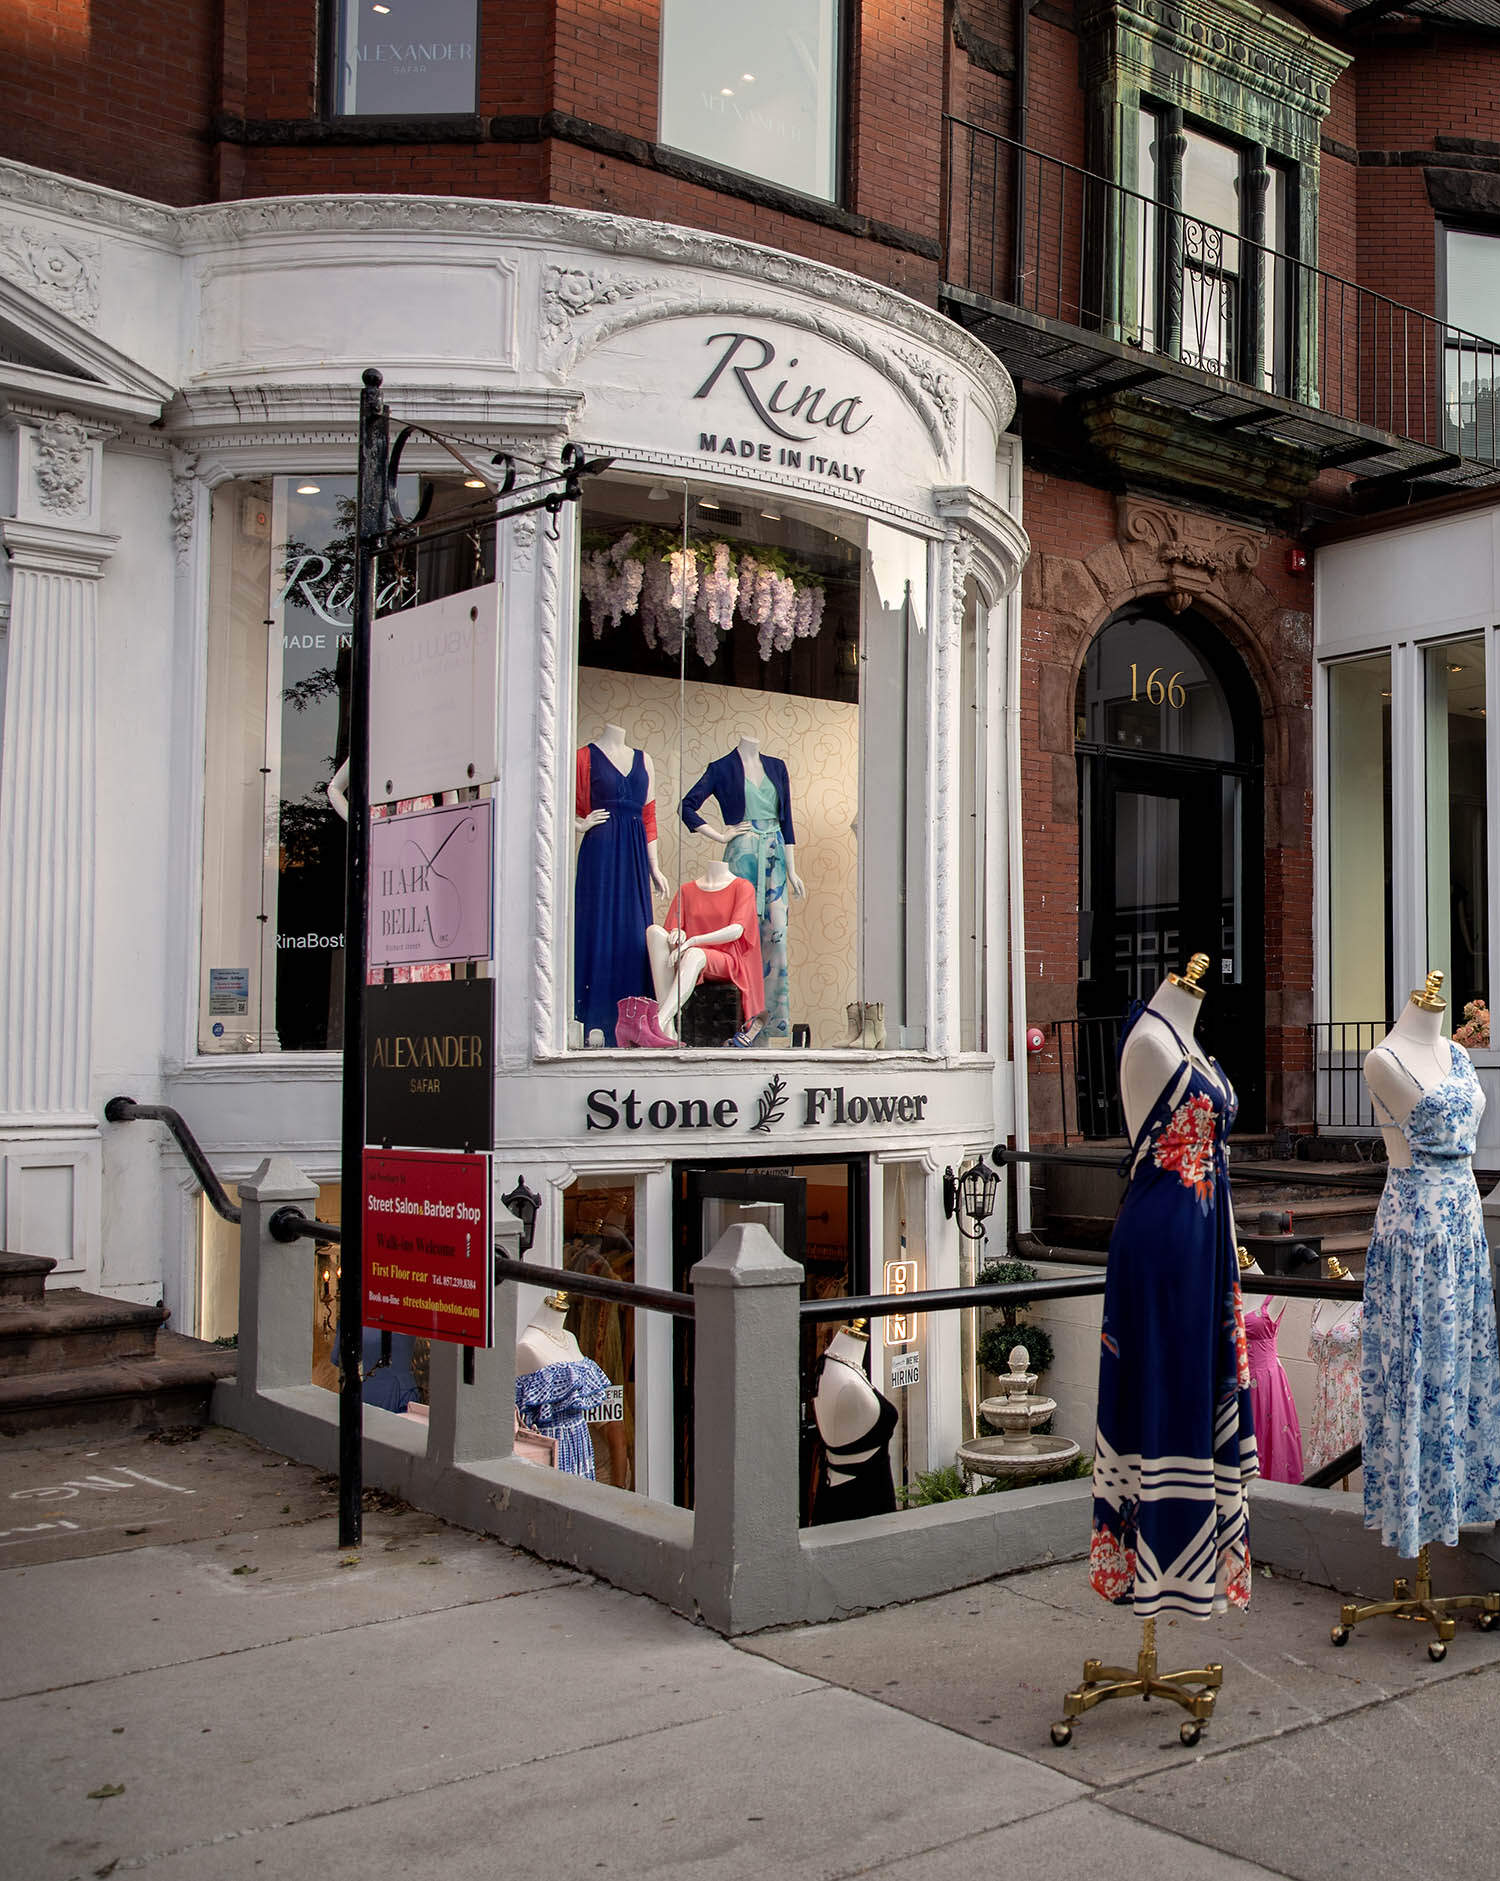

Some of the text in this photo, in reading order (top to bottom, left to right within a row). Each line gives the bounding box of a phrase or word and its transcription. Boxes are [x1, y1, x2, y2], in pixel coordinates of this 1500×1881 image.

[350, 43, 471, 61] ALEXANDER
[693, 332, 873, 442] Rina
[700, 433, 866, 484] MADE IN ITALY
[272, 555, 421, 627] Ria
[1129, 663, 1186, 709] 166
[381, 865, 430, 897] HAIR
[381, 904, 433, 937] BELLA
[372, 1034, 483, 1068] ALEXANDER
[410, 1078, 441, 1094] SAFAR
[586, 1086, 929, 1131] Stone Flower
[368, 1194, 394, 1213] Street
[456, 1202, 481, 1225] Shop
[372, 1261, 389, 1278] First
[390, 1264, 410, 1281] Floor
[412, 1271, 429, 1283] rear
[368, 1290, 381, 1303] Book
[402, 1295, 480, 1319] streetsalonboston.com
[906, 1355, 919, 1365] WE'RE
[891, 1367, 919, 1388] HIRING
[606, 1389, 623, 1399] E'RE
[583, 1403, 623, 1421] IRING
